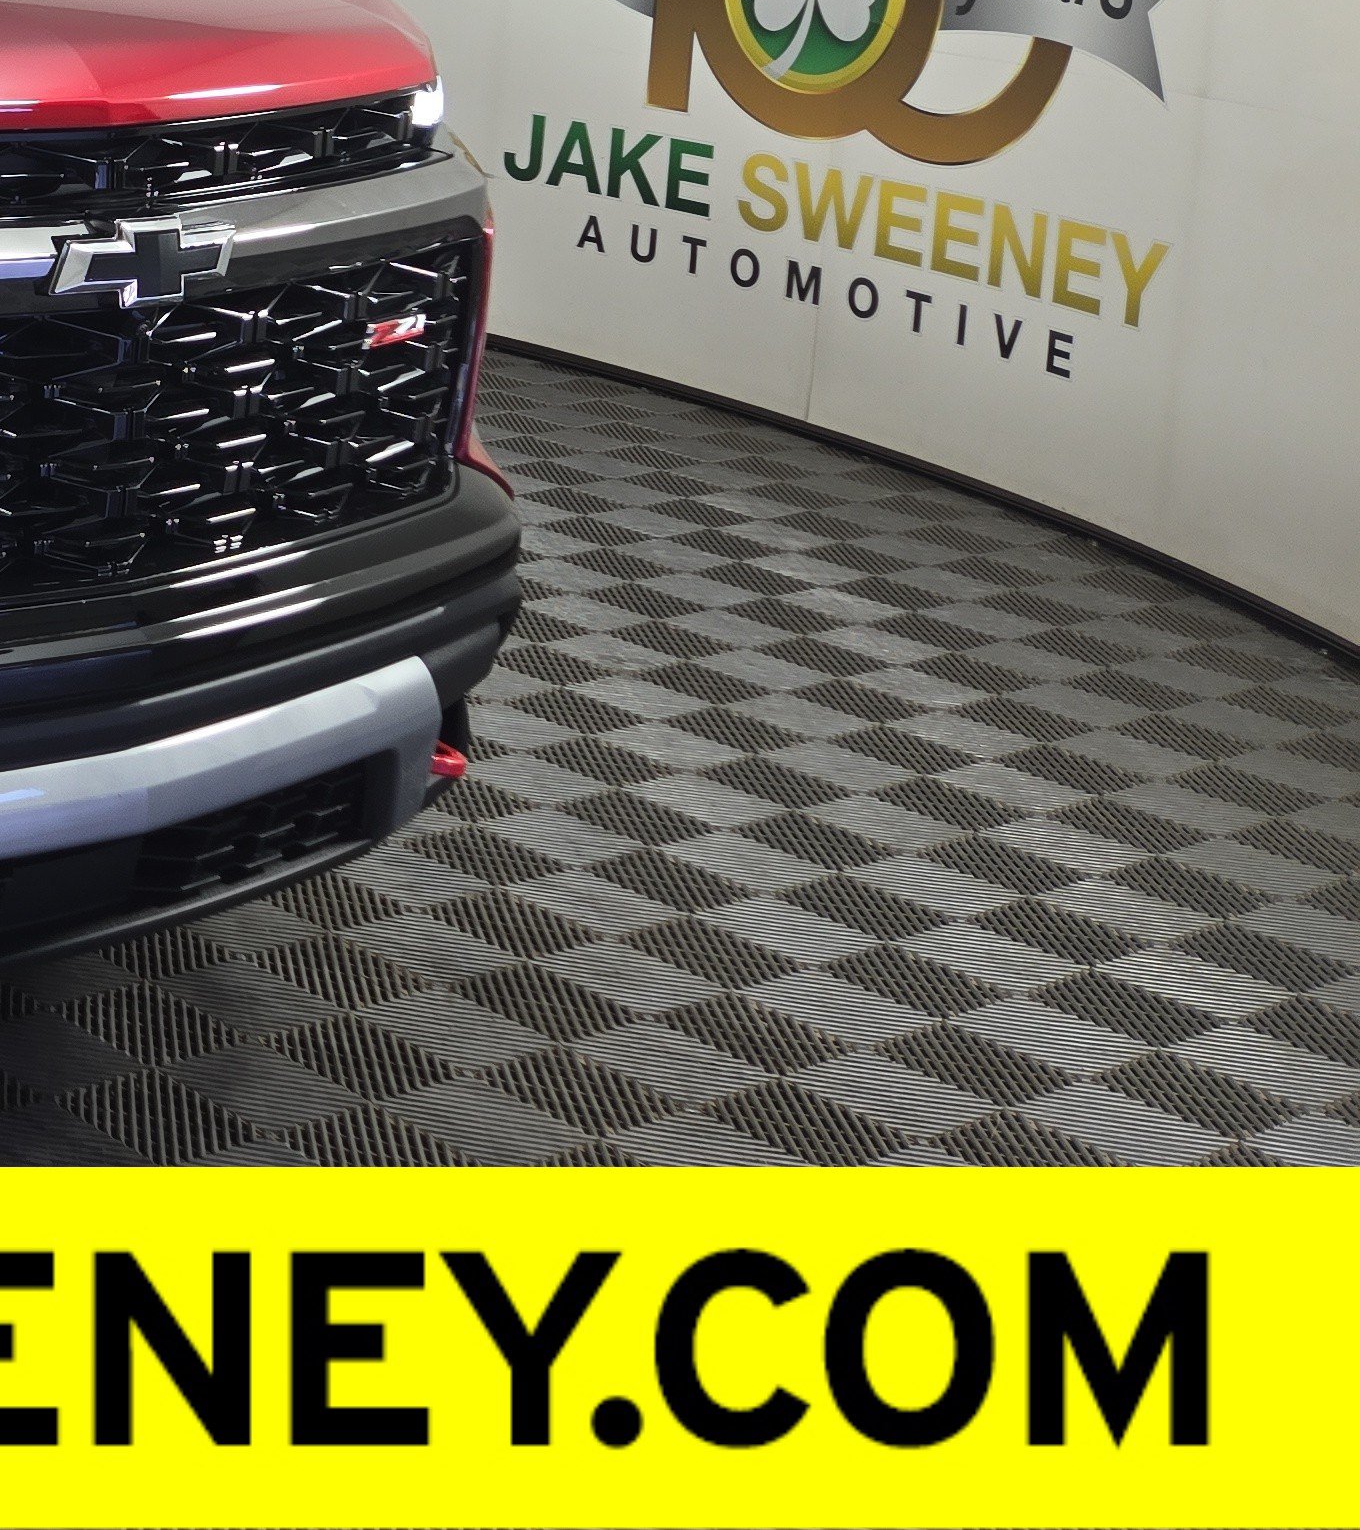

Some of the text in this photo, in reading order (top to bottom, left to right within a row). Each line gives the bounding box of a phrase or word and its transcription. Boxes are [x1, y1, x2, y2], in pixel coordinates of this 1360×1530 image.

[503, 114, 1171, 328] JAKE SWEENEY
[576, 215, 1074, 379] AUTOMOTIVE
